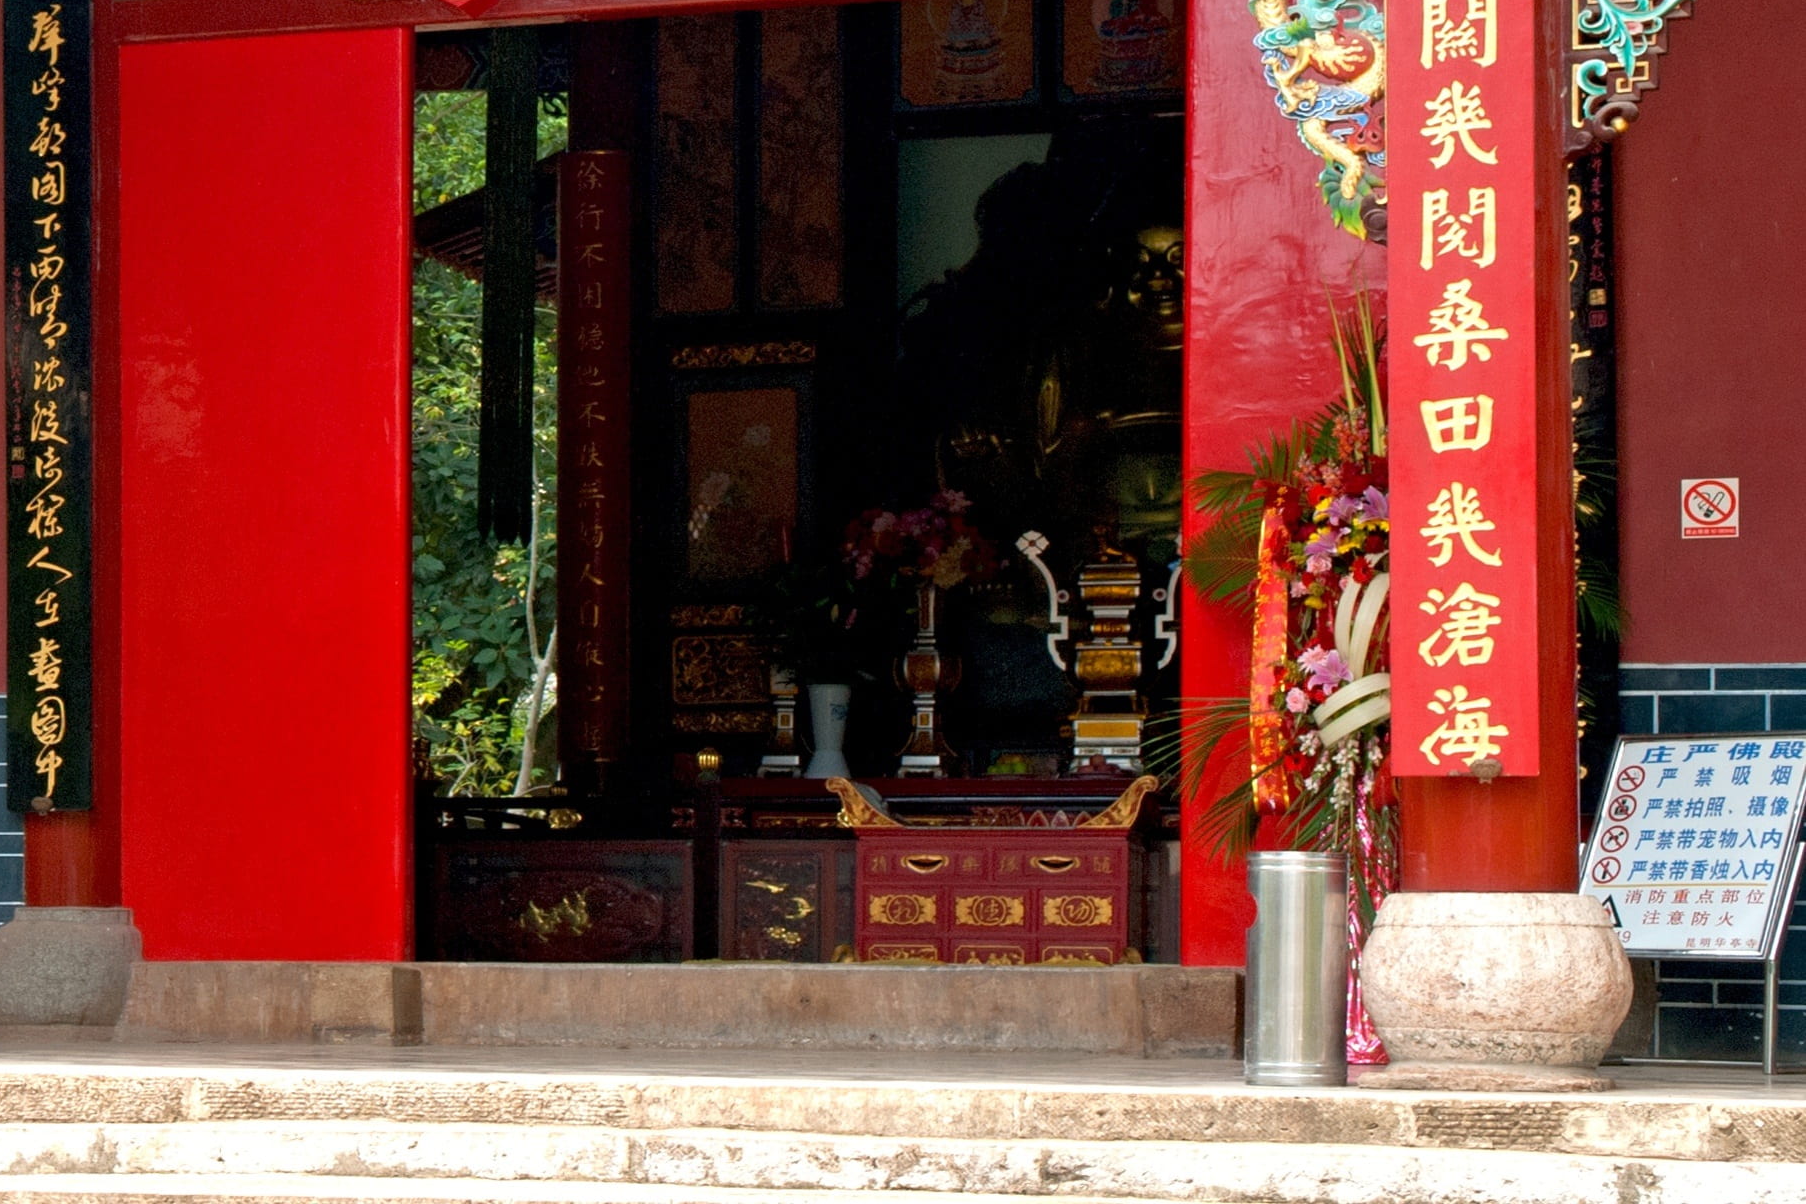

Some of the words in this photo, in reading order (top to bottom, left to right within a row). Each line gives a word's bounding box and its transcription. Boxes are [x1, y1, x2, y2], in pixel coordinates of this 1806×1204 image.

[1640, 741, 1805, 764] 庄严佛殿
[1657, 765, 1793, 788] 严禁吸烟
[1642, 796, 1789, 819] 严禁拍照、摄像
[1634, 828, 1783, 850] 严禁带宠物入内
[1627, 859, 1775, 881] 严禁带香烛入内
[1624, 889, 1765, 905] 消防重点部位
[1641, 910, 1735, 926] 注意防火
[1684, 938, 1759, 950] 昆明华亭寺
